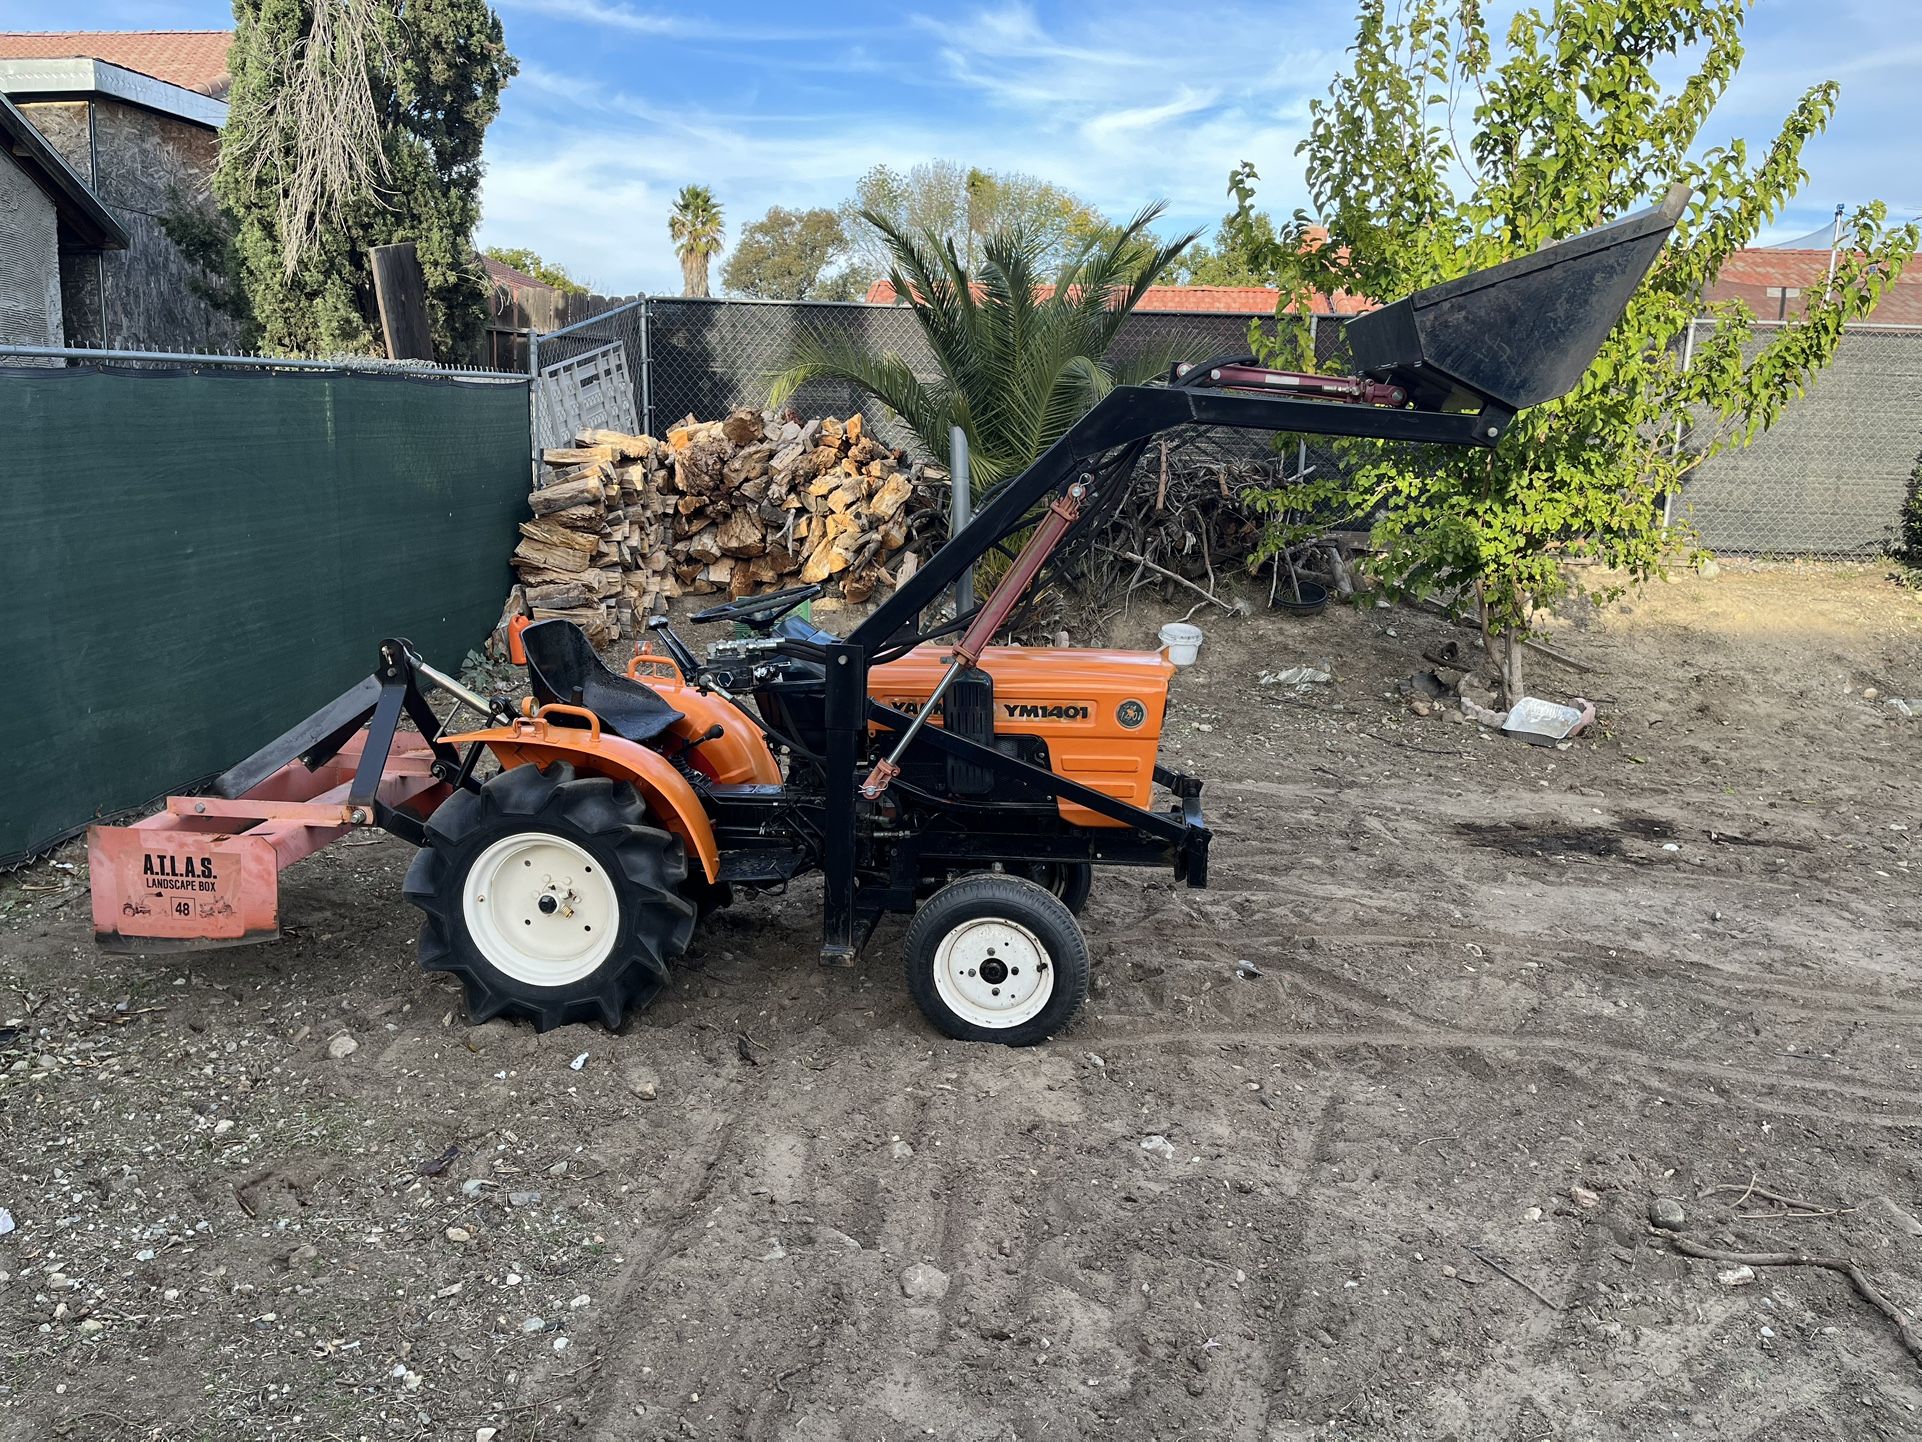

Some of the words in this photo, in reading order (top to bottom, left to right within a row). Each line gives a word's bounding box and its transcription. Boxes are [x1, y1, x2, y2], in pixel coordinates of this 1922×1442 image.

[1003, 704, 1088, 719] YM1401
[143, 853, 218, 879] A.T.L.A.S.
[146, 877, 197, 891] LANDSCAPE
[198, 881, 216, 892] BOX
[175, 902, 190, 916] 48
